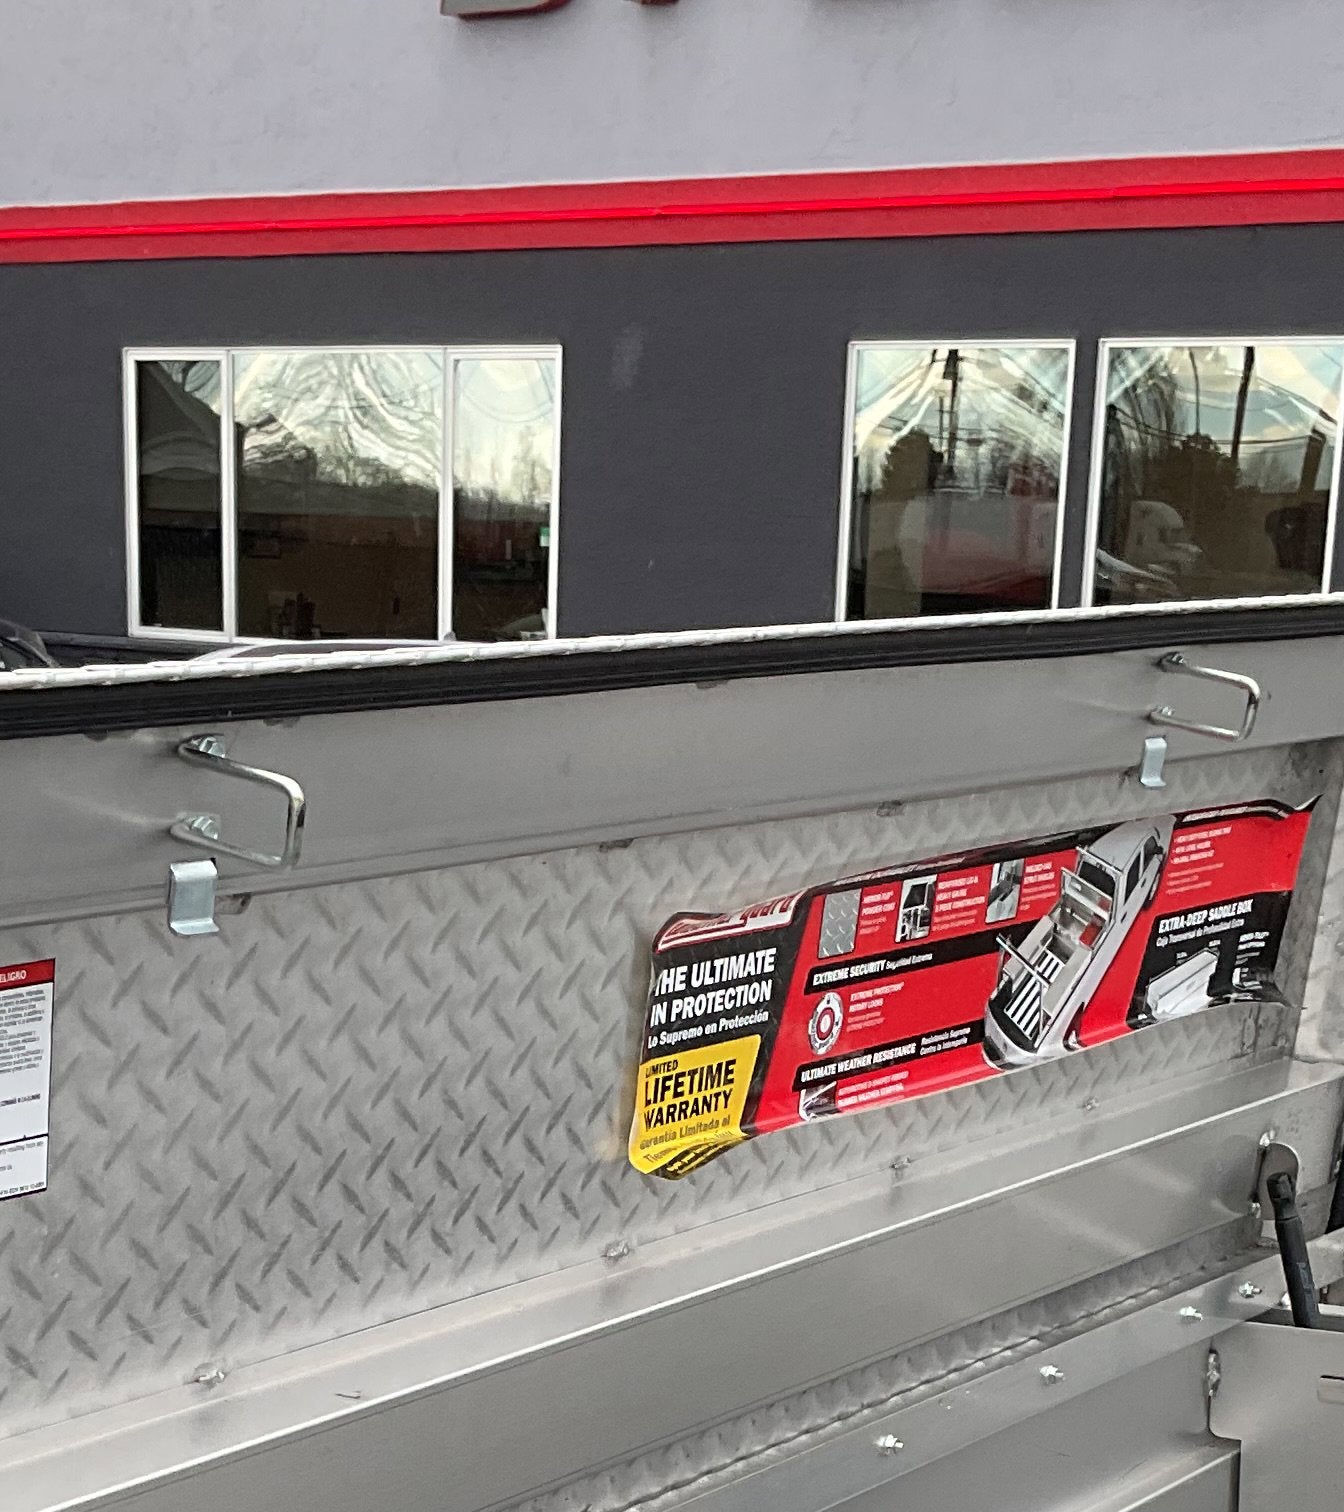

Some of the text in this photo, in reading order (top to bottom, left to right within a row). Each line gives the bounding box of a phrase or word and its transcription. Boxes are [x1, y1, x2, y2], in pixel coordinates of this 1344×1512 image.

[1158, 899, 1254, 934] EXTRA-DEEP SADDLE BOX
[654, 947, 777, 997] THE ULTIMATE
[812, 967, 850, 986] EXTREME
[849, 959, 887, 978] SECURITY
[650, 979, 773, 1028] IN PROTECTION
[647, 1008, 769, 1049] Lo Supremo en Protección
[644, 1058, 737, 1108] LIFETIME
[645, 1059, 678, 1078] LIMITED
[801, 1042, 917, 1083] ULTIMATE WEATHER RESISTANCE
[643, 1088, 733, 1132] WARRANTY
